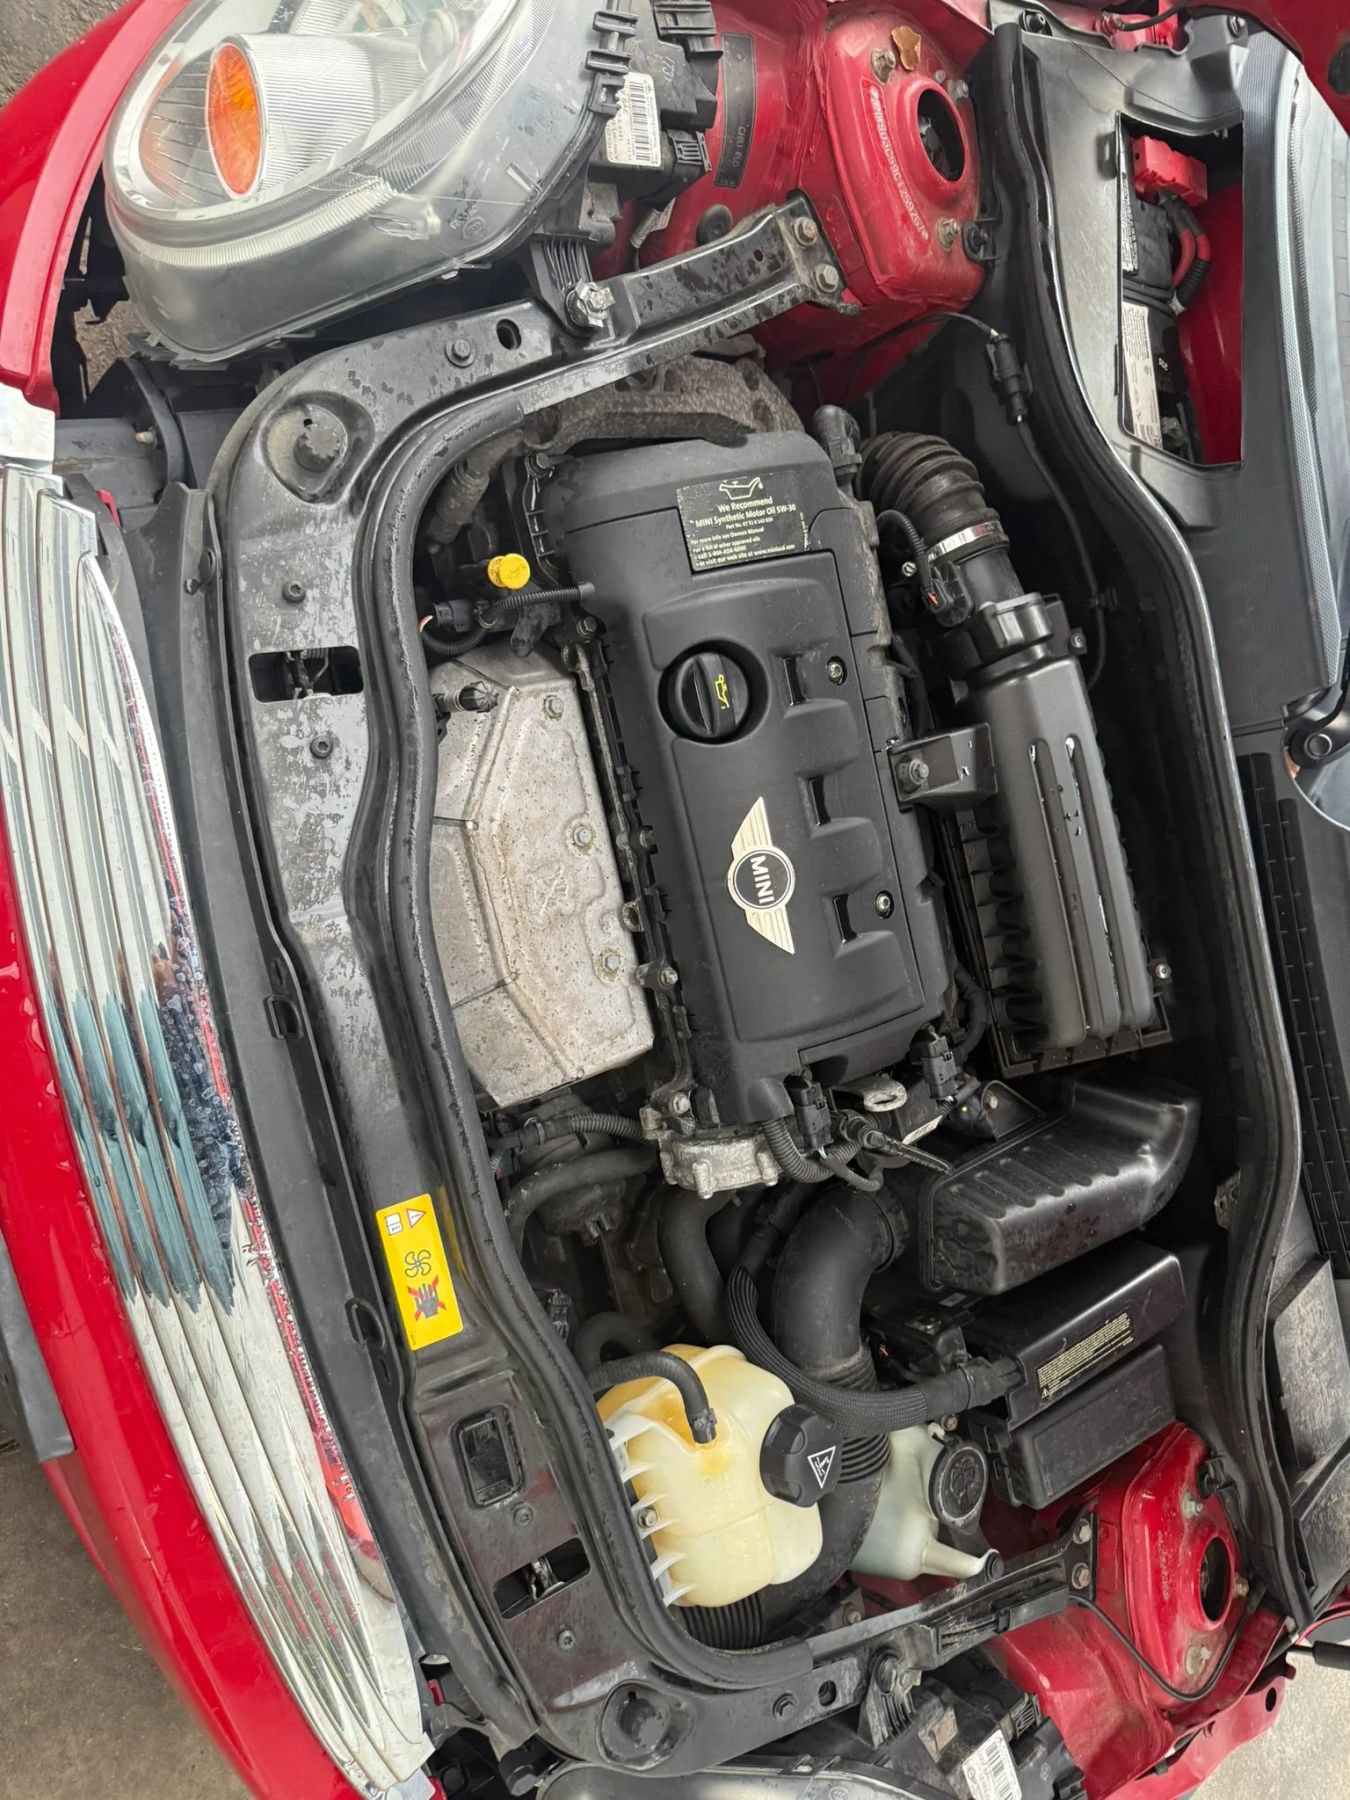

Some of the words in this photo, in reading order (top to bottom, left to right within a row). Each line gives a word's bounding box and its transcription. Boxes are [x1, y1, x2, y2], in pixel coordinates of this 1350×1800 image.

[694, 517, 713, 527] MINI
[713, 512, 745, 525] Synthetic
[745, 509, 765, 518] Motor
[766, 506, 776, 514] Oil
[776, 504, 796, 513] 5W-30
[717, 504, 730, 512] We
[731, 496, 773, 510] Recommend
[750, 855, 775, 904] MINI
